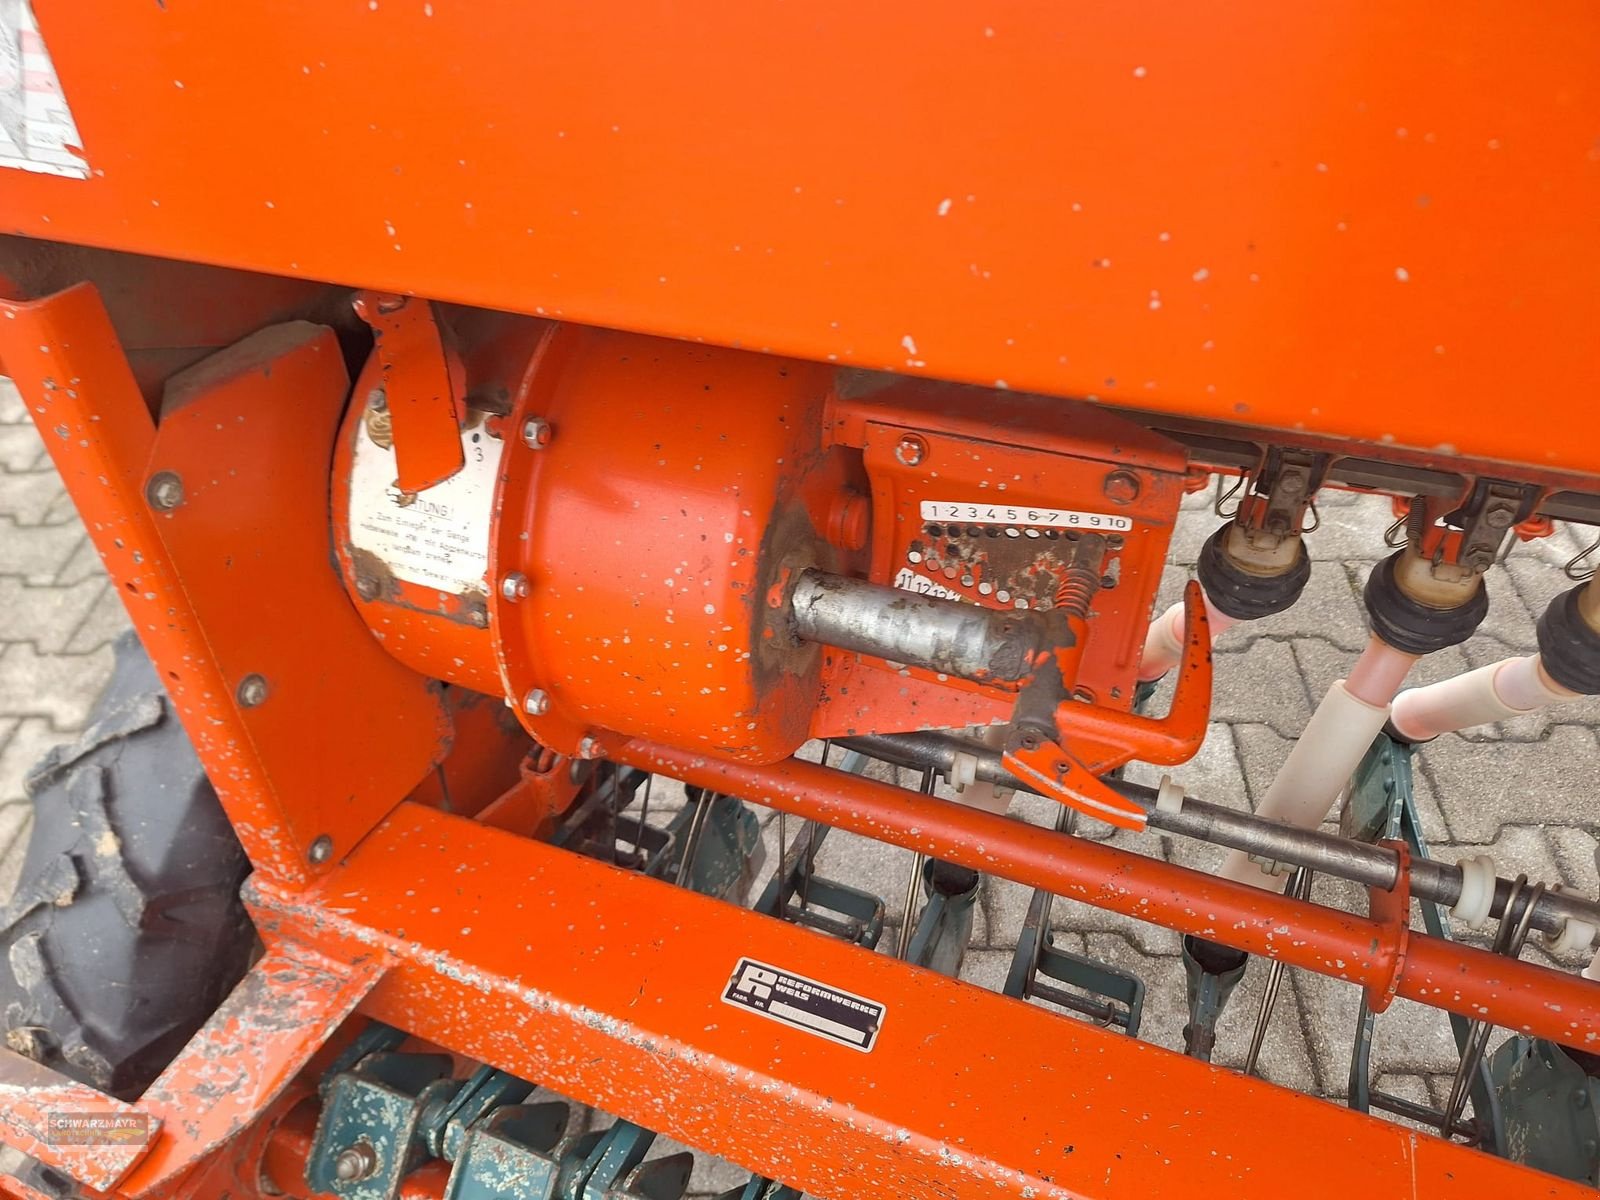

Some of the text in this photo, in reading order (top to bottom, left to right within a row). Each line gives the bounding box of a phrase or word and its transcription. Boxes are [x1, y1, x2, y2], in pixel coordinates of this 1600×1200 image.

[474, 446, 484, 462] 3
[931, 505, 1126, 529] 1 2 3 4 5 6 7 8 9 10
[775, 983, 810, 1001] WELS
[777, 975, 879, 1017] REFORMWERKE
